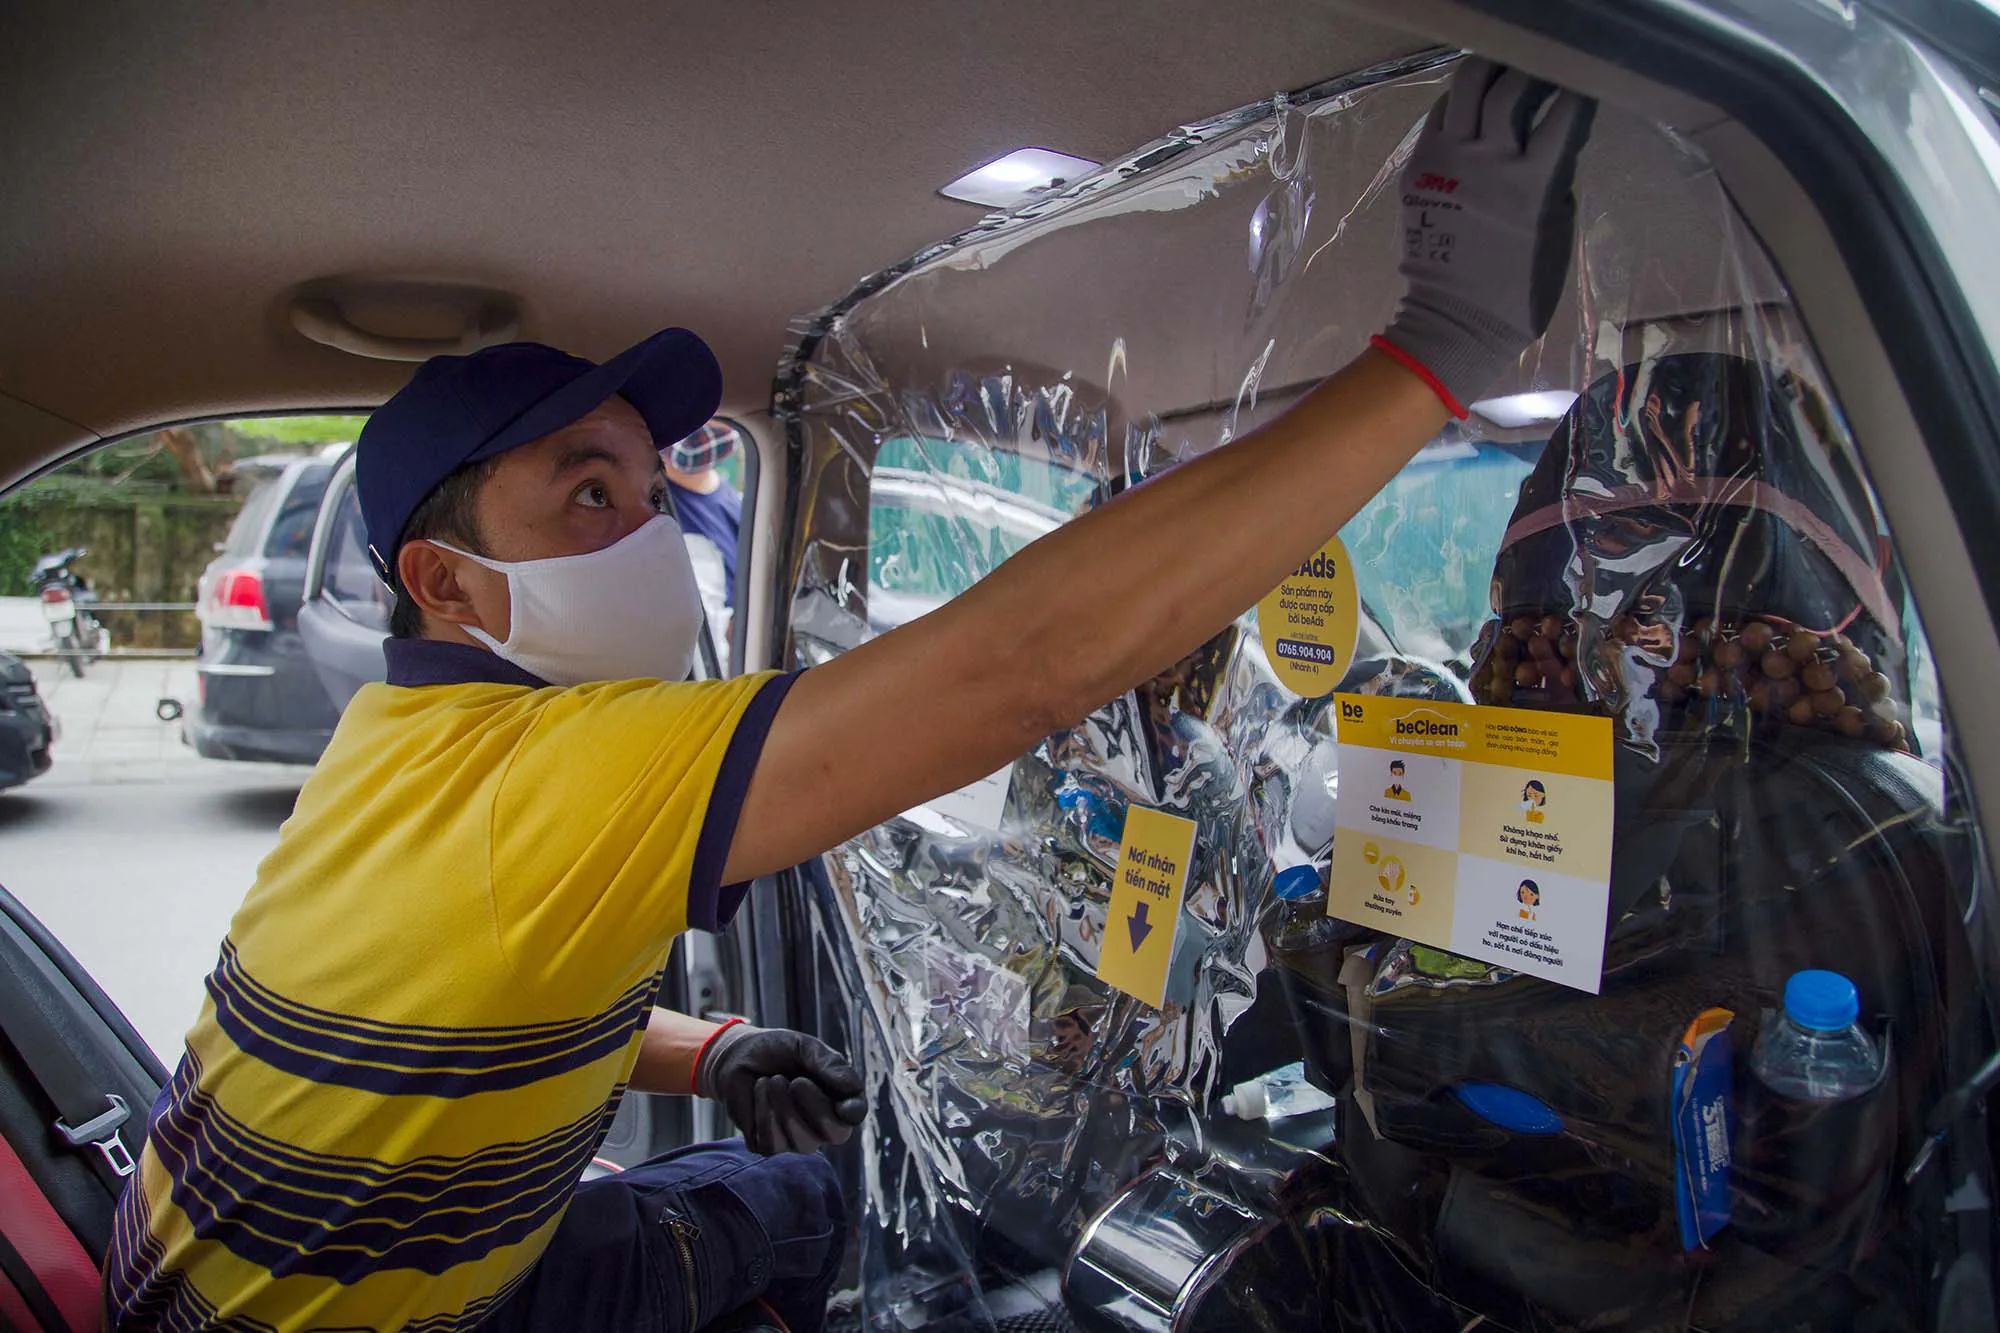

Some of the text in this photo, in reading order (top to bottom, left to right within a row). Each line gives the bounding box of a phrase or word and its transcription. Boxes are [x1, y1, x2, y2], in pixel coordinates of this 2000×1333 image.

[1416, 172, 1458, 193] 3M
[1422, 212, 1434, 228] L
[1281, 584, 1333, 600] Sản phẩm này
[1280, 599, 1334, 616] được cung cấp
[1288, 613, 1324, 627] bởi beAds
[1278, 643, 1332, 661] 0765.904.904
[1312, 666, 1319, 675] 4)
[1342, 701, 1364, 718] be
[1396, 719, 1458, 736] beClean
[1402, 821, 1418, 831] trang
[1504, 825, 1524, 837] Không
[1526, 829, 1544, 840] khạc
[1510, 837, 1527, 848] dụng
[1128, 846, 1176, 876] Nơi nhận
[1518, 848, 1528, 858] ho,
[1147, 880, 1170, 901] mặt
[1496, 921, 1552, 942] Hạn chế tiếp xúc
[1482, 938, 1492, 947] ho,
[1494, 942, 1504, 950] sốt
[1524, 950, 1542, 962] đông
[1542, 956, 1564, 966] người
[1499, 933, 1518, 943] người
[1529, 941, 1543, 950] dấu
[1544, 944, 1560, 954] hiệu
